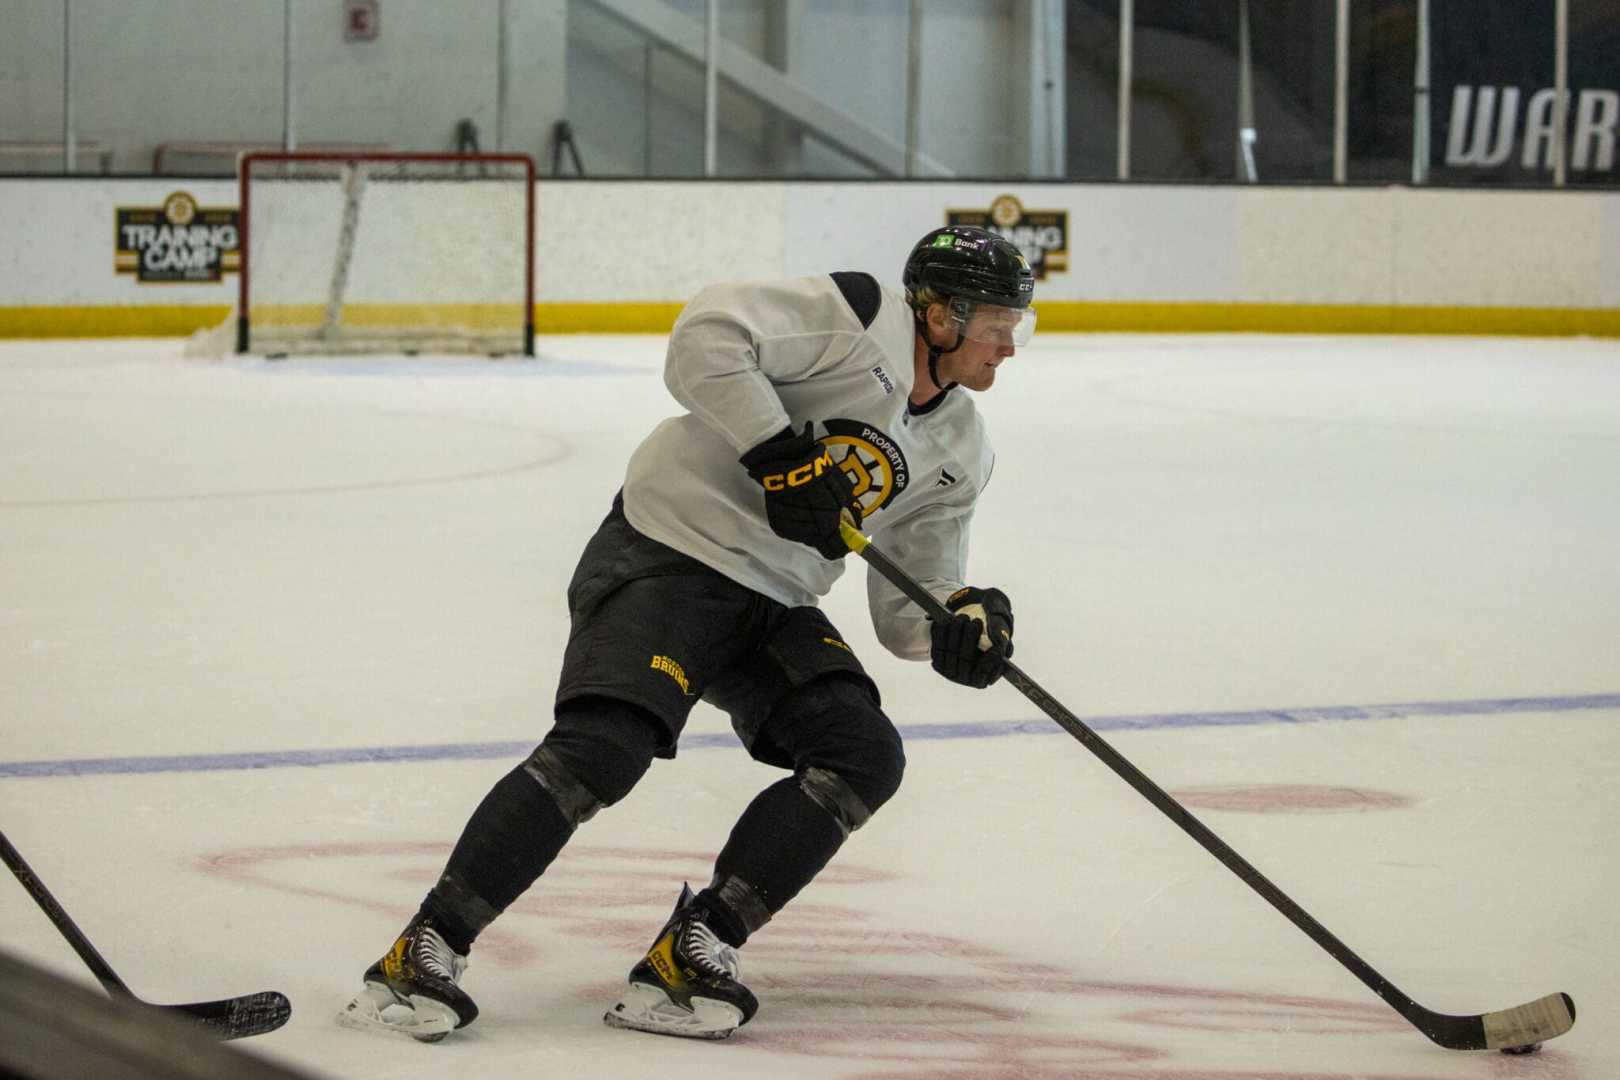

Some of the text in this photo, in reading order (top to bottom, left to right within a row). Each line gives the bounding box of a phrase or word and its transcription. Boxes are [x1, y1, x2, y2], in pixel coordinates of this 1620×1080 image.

[1445, 85, 1619, 170] WAR
[122, 224, 238, 249] TRAINING
[955, 238, 978, 249] Bank
[145, 246, 218, 271] CAMP
[763, 450, 833, 491] CCM
[862, 428, 905, 488] PROPERTY OF
[650, 655, 689, 695] BRUINS
